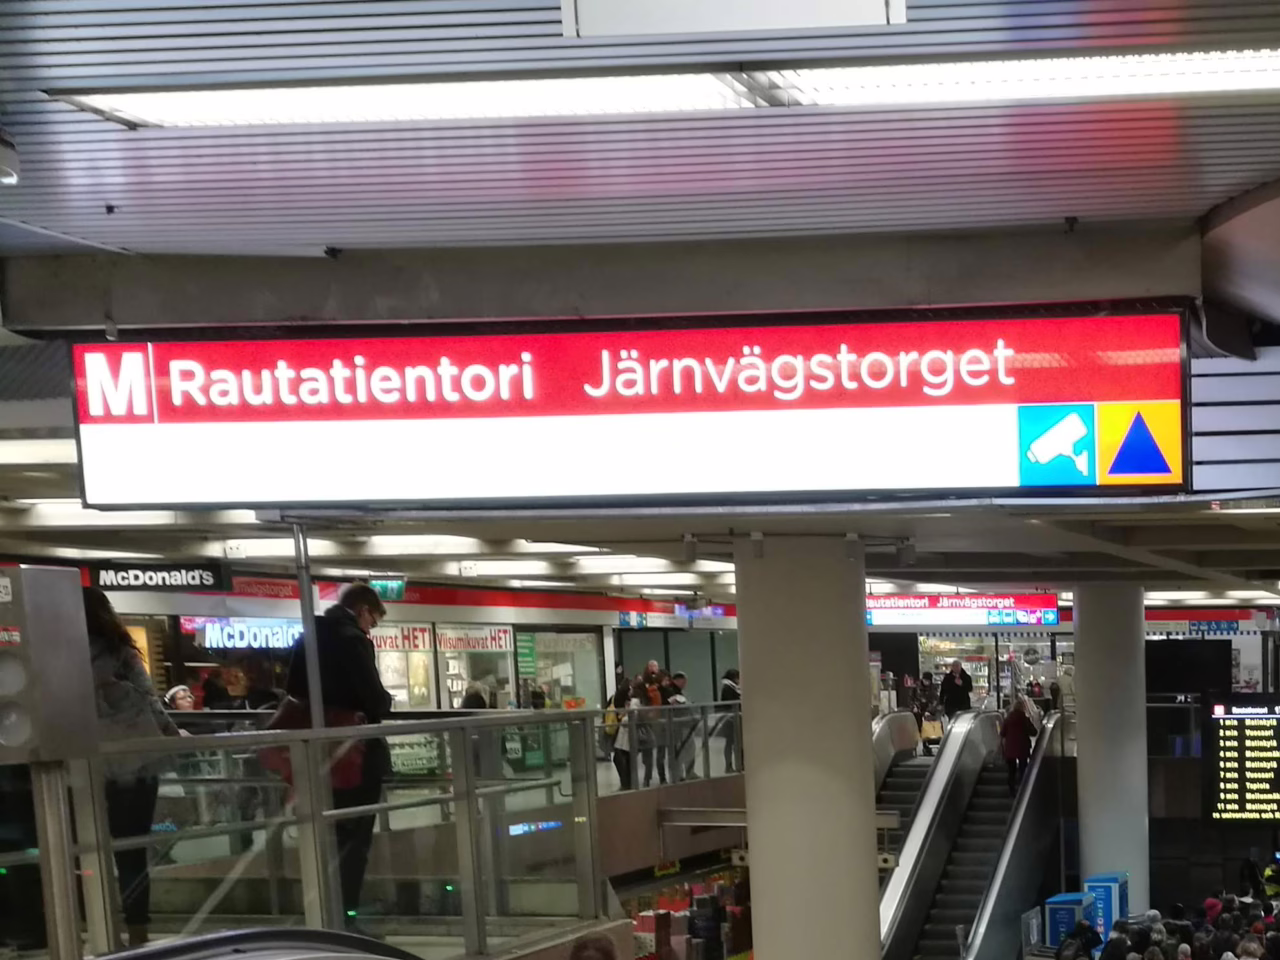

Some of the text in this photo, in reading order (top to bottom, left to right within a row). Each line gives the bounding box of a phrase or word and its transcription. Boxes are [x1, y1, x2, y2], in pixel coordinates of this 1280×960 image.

[84, 340, 1015, 416] M Rautatientori Järnvägstorget
[98, 568, 215, 587] McDonald's
[866, 597, 1015, 608] autatientori Järnvägstorget
[401, 626, 432, 649] HETI
[436, 632, 489, 649] Viisumikuvat
[490, 628, 512, 649] HETI
